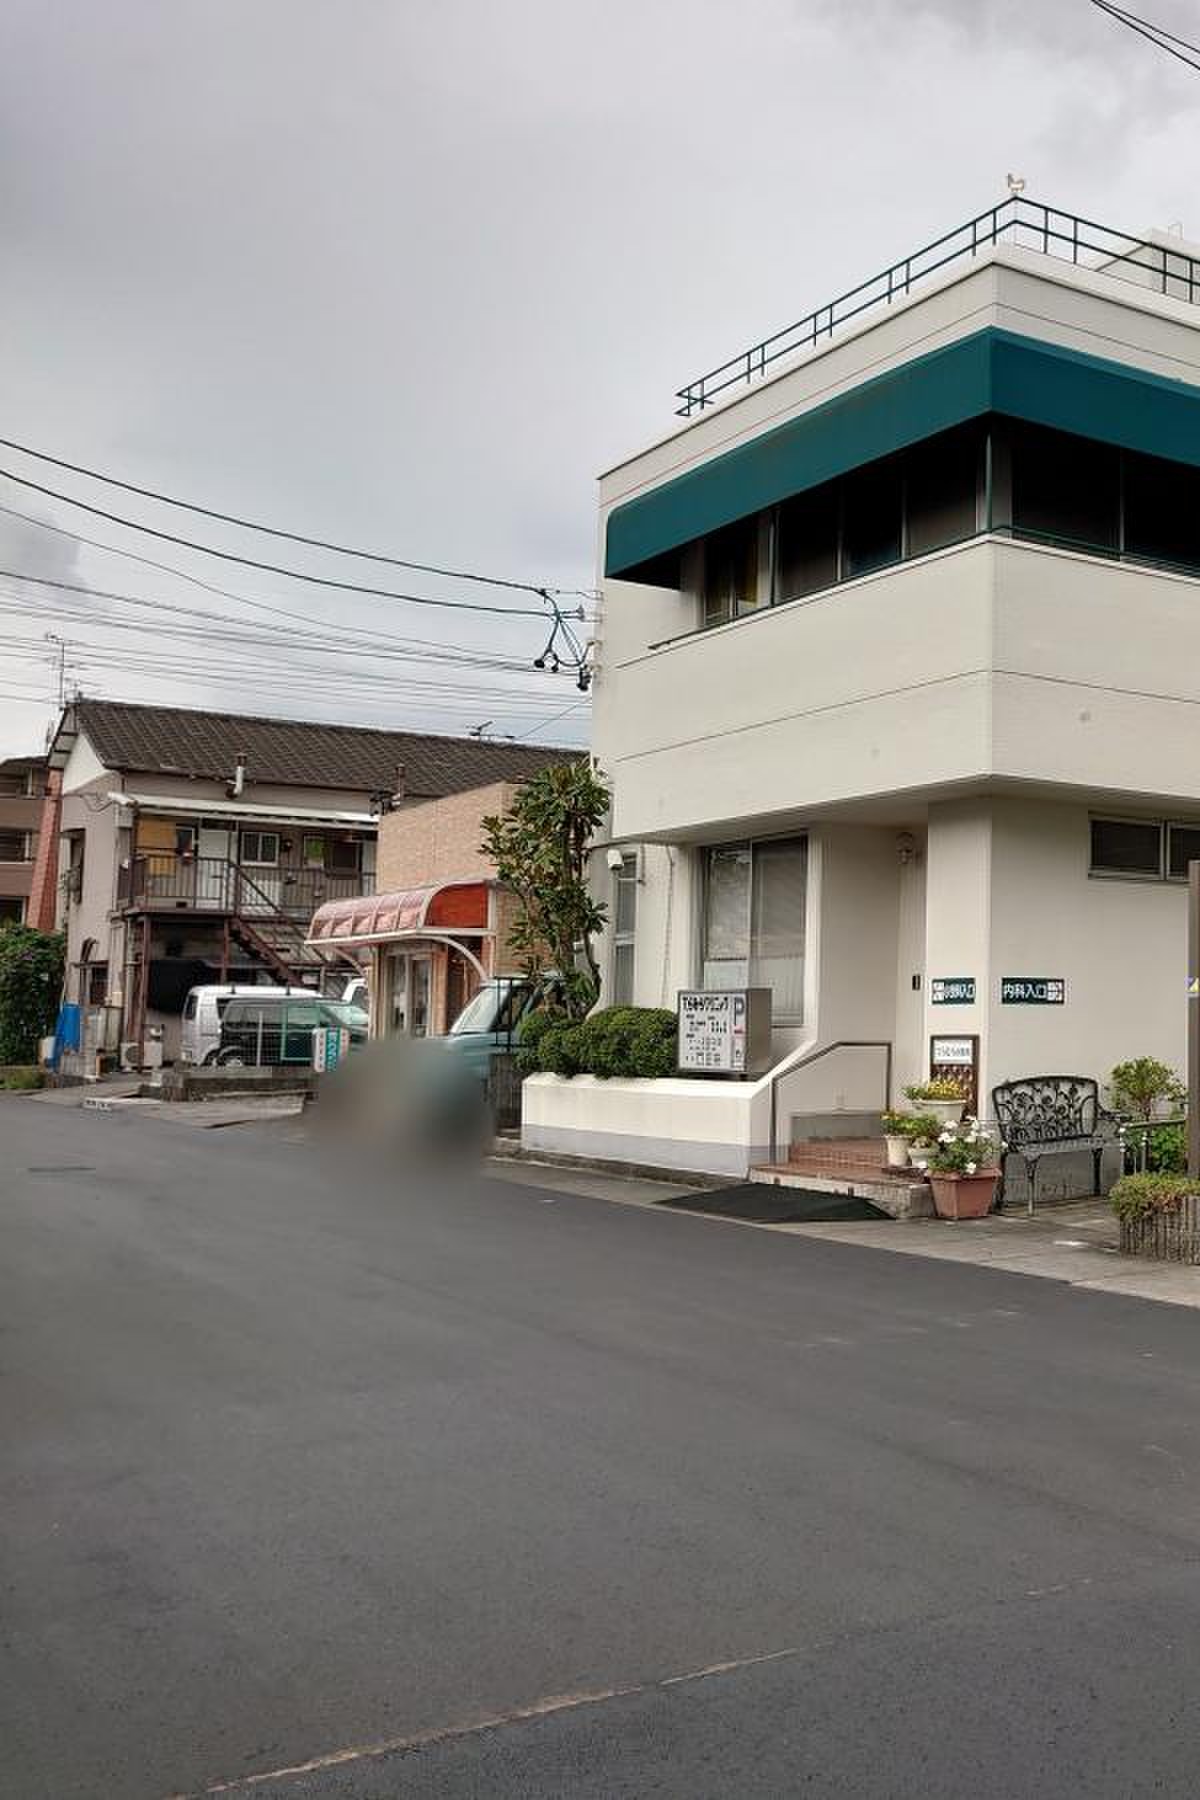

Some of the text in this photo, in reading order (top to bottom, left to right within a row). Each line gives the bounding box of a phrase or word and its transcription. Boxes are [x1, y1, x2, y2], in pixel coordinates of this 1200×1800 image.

[1003, 983, 1047, 999] 内科入口
[734, 996, 745, 1026] P
